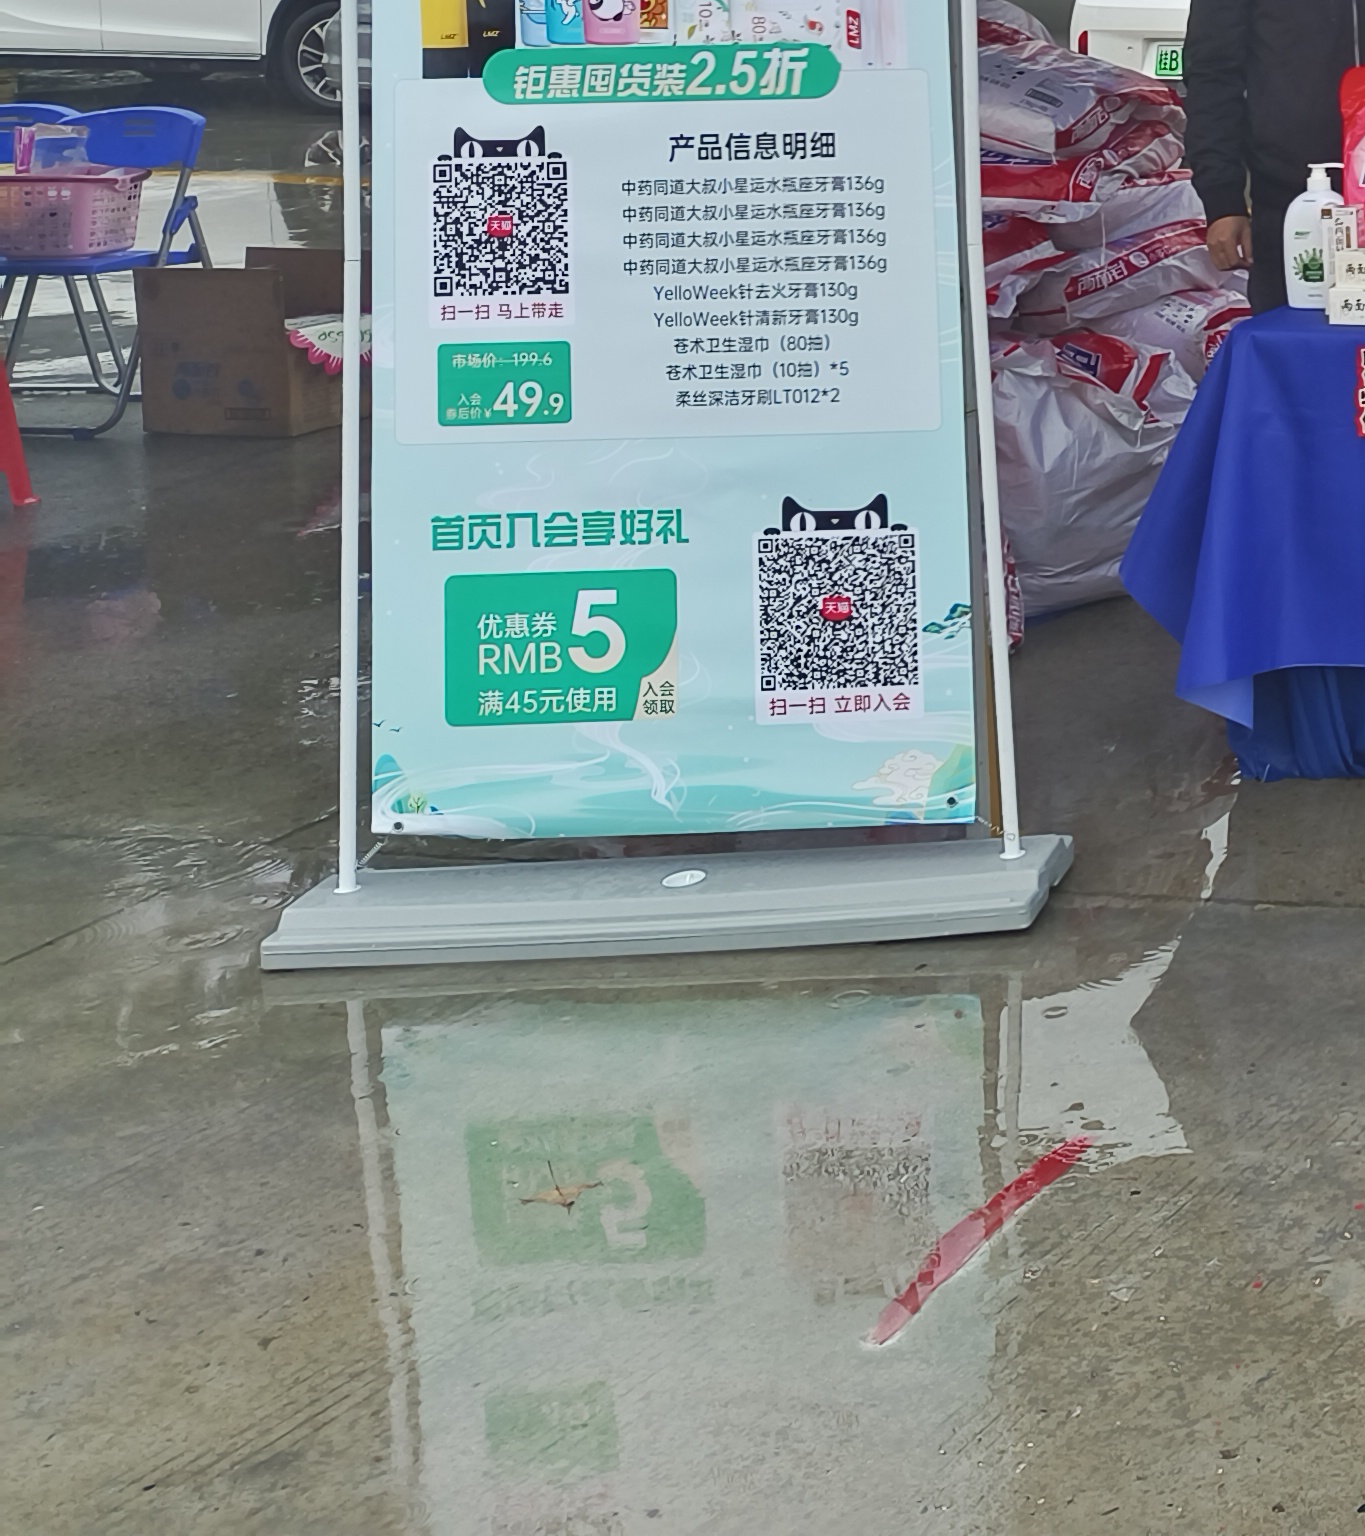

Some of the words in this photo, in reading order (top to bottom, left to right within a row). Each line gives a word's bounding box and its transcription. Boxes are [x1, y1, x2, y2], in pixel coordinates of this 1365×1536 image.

[1159, 49, 1180, 72] 桂B
[514, 48, 808, 100] 钜惠囤货装2.5折
[668, 131, 837, 162] 产品信息明细
[621, 176, 885, 196] 中药同道大叔小星运水瓶座牙膏136g
[622, 202, 886, 223] 中药同道大叔小星运水瓶座牙膏136g
[622, 229, 887, 249] 中药同道大叔小星运水瓶座牙膏136g
[623, 255, 888, 276] 中药同道大叔小星运水瓶座牙膏136g
[653, 282, 858, 301] YelloWeek针去火牙膏130g
[441, 304, 490, 321] 扫一扫
[497, 302, 564, 320] 马上带走
[653, 308, 859, 328] YelloWeek针清新牙膏130g
[492, 380, 564, 419] 49.9
[430, 507, 689, 552] 首页入会享好礼
[477, 611, 557, 641] 优惠券
[567, 589, 627, 674] 5
[477, 643, 563, 676] RMB
[641, 680, 675, 698] 入会
[477, 687, 617, 717] 满45元使用
[641, 698, 676, 716] 领取
[769, 695, 826, 718] 扫一扫
[834, 690, 912, 714] 立即入会
